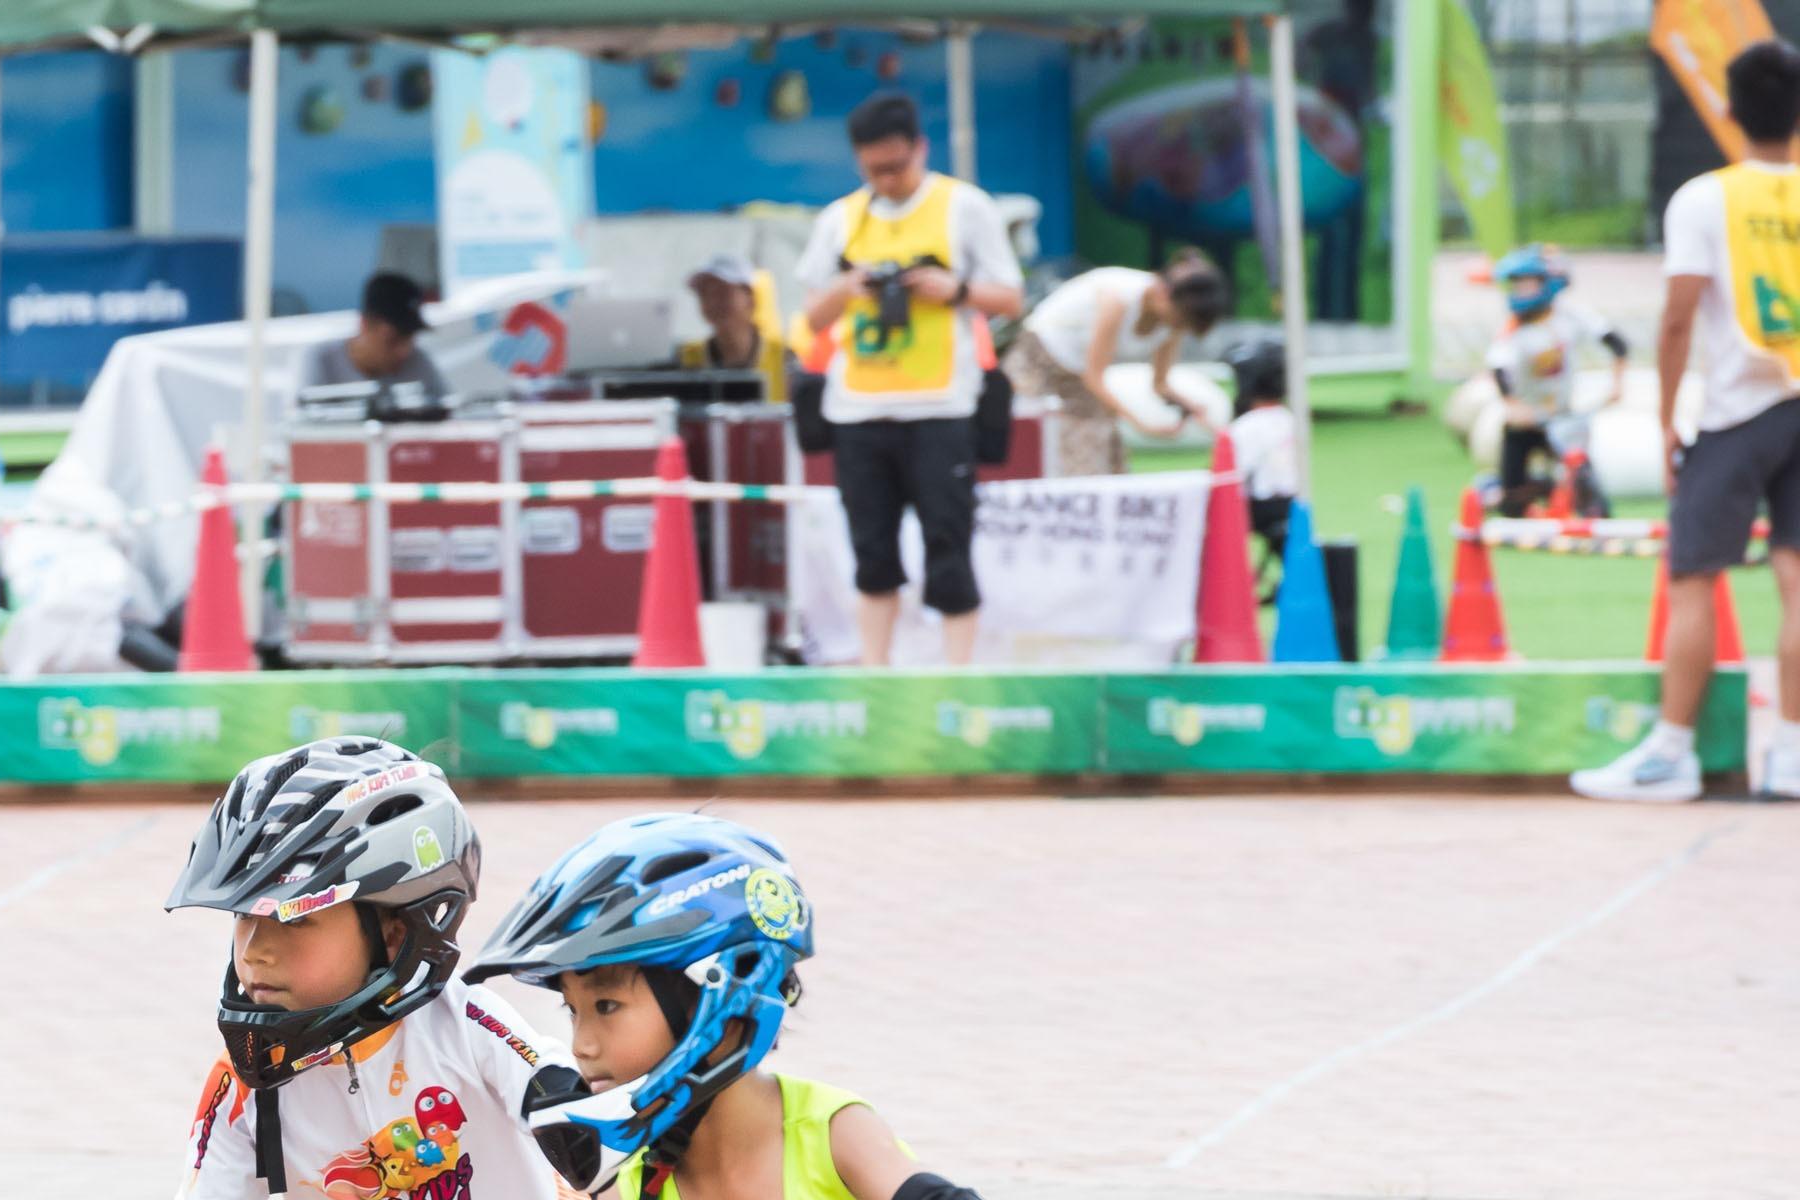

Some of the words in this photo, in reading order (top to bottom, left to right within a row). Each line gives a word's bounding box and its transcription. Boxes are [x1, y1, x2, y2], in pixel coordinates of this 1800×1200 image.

[8, 282, 95, 333] pierre
[101, 279, 189, 325] cardin
[648, 863, 751, 915] CRATONI
